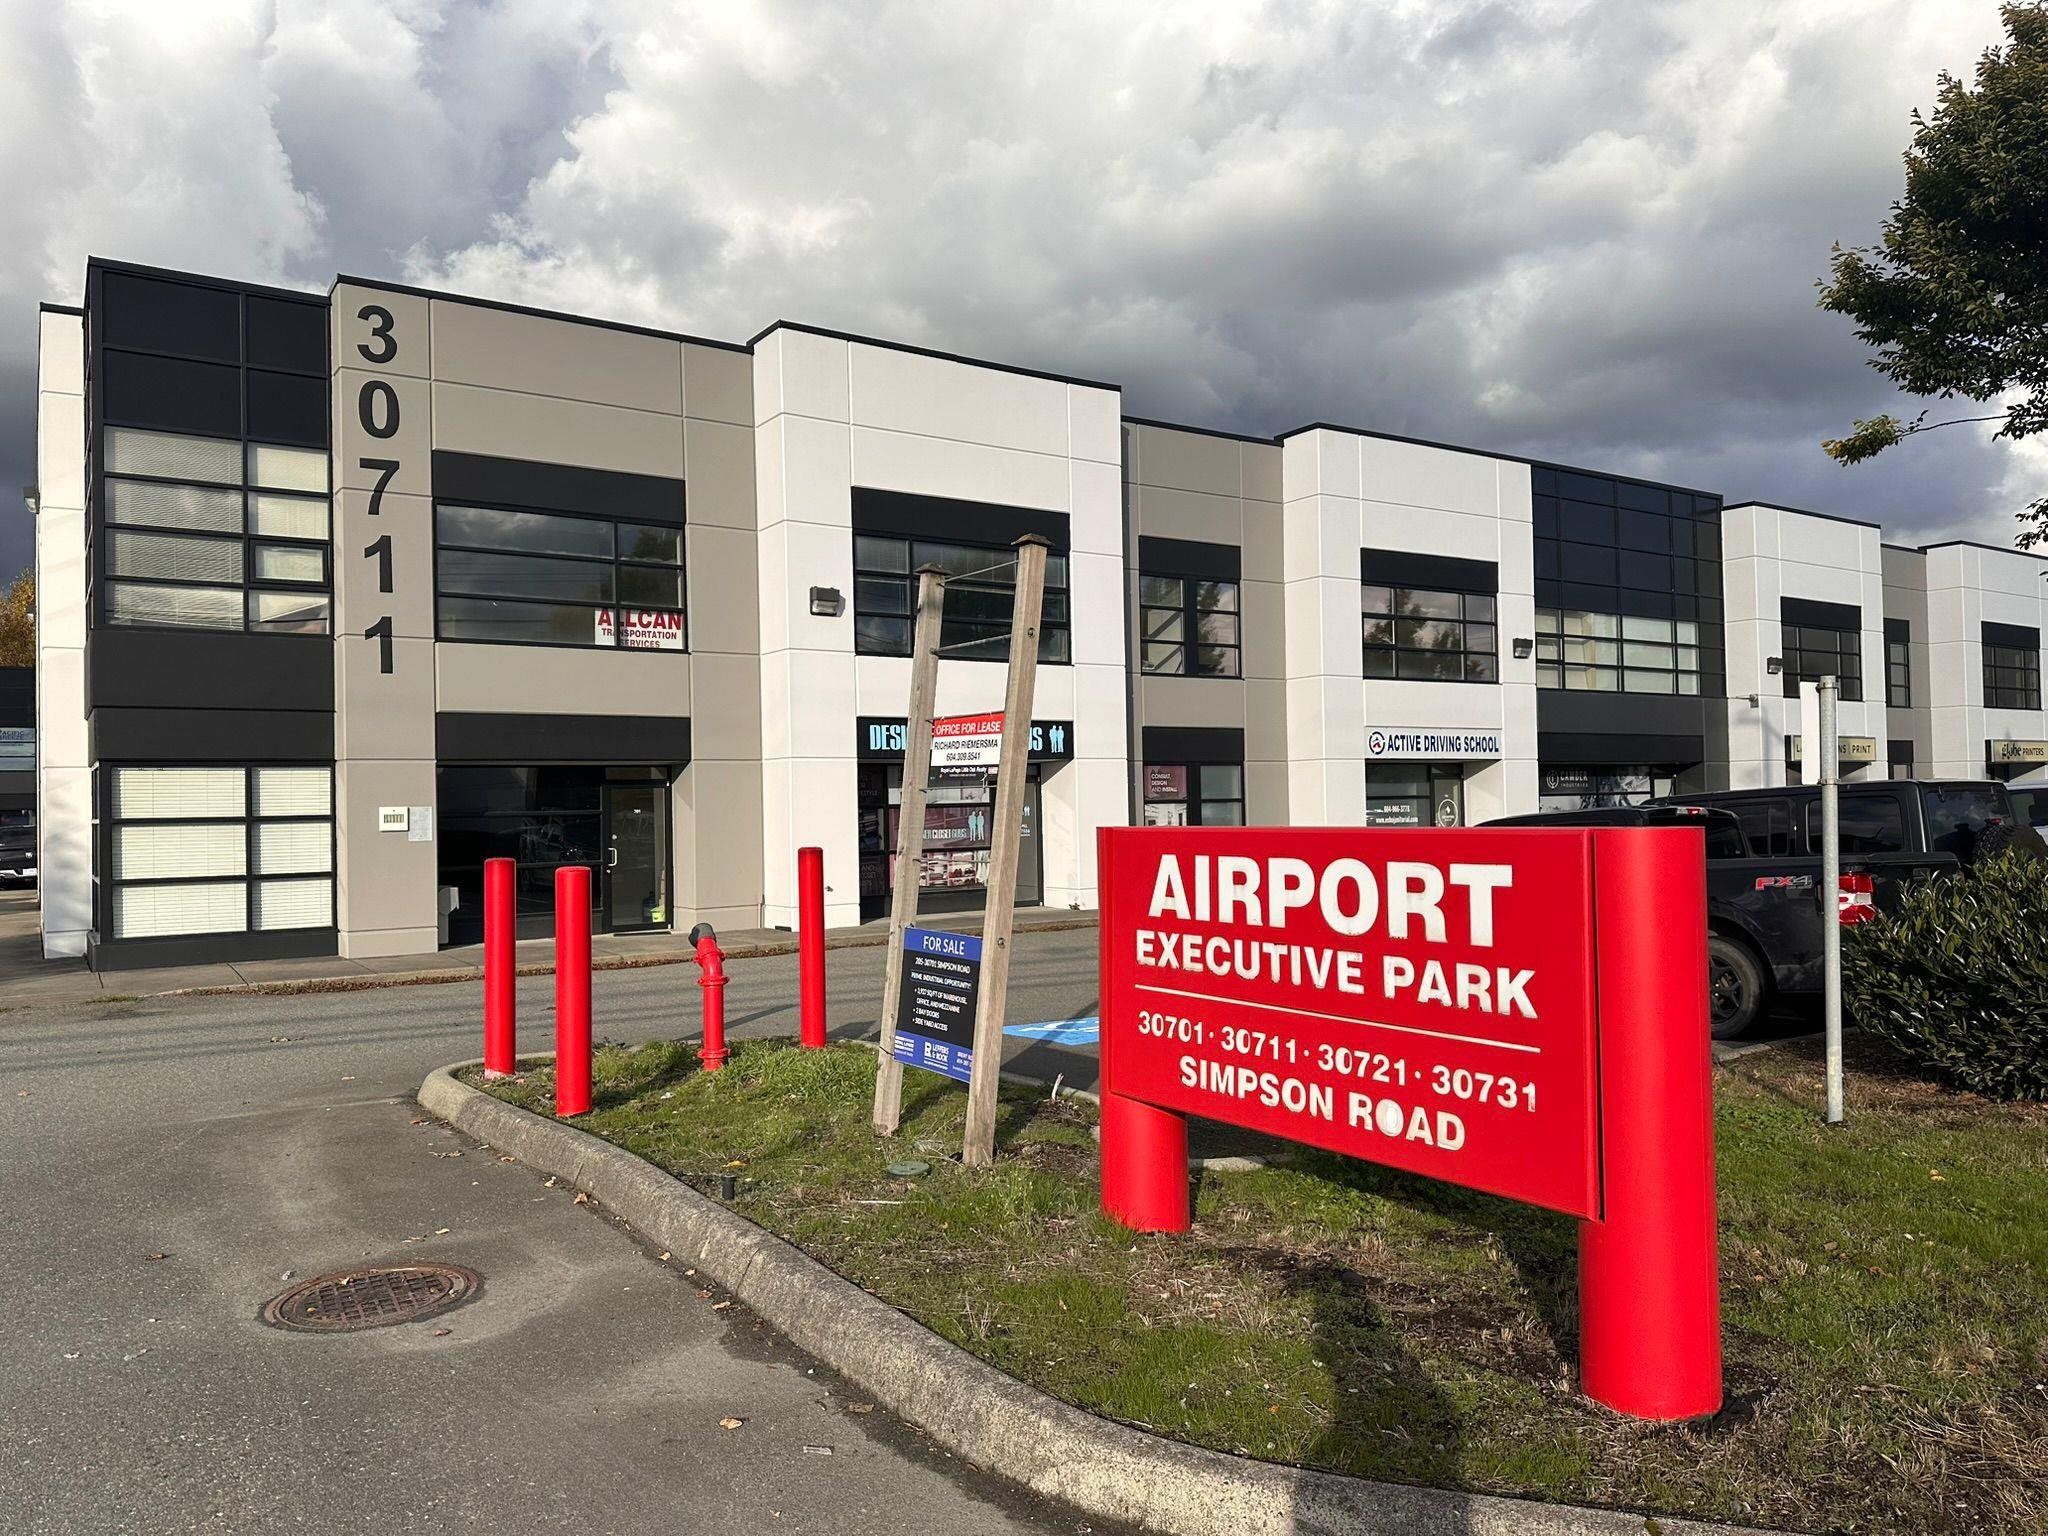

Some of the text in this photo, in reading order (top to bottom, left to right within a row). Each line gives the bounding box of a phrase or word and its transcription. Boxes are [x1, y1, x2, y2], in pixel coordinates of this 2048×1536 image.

[356, 304, 400, 674] 30711
[598, 608, 683, 630] ALCAN
[602, 628, 677, 639] TRNSPORTATION
[936, 720, 1001, 735] OFFICE FOR LEASE
[934, 740, 960, 750] RICHARD
[1387, 734, 1499, 753] ACTIVE DRIVING SCHOOL
[1851, 744, 1871, 754] PRINT
[1755, 875, 1813, 891] FX4
[1147, 853, 1513, 948] AIRPORT
[923, 935, 966, 955] FOR SALE
[1135, 929, 1539, 1020] EXECUTIVE PARK
[1137, 1011, 1537, 1113] 30701 30711 30721 30731
[1178, 1054, 1467, 1152] SIMPSON ROAD
